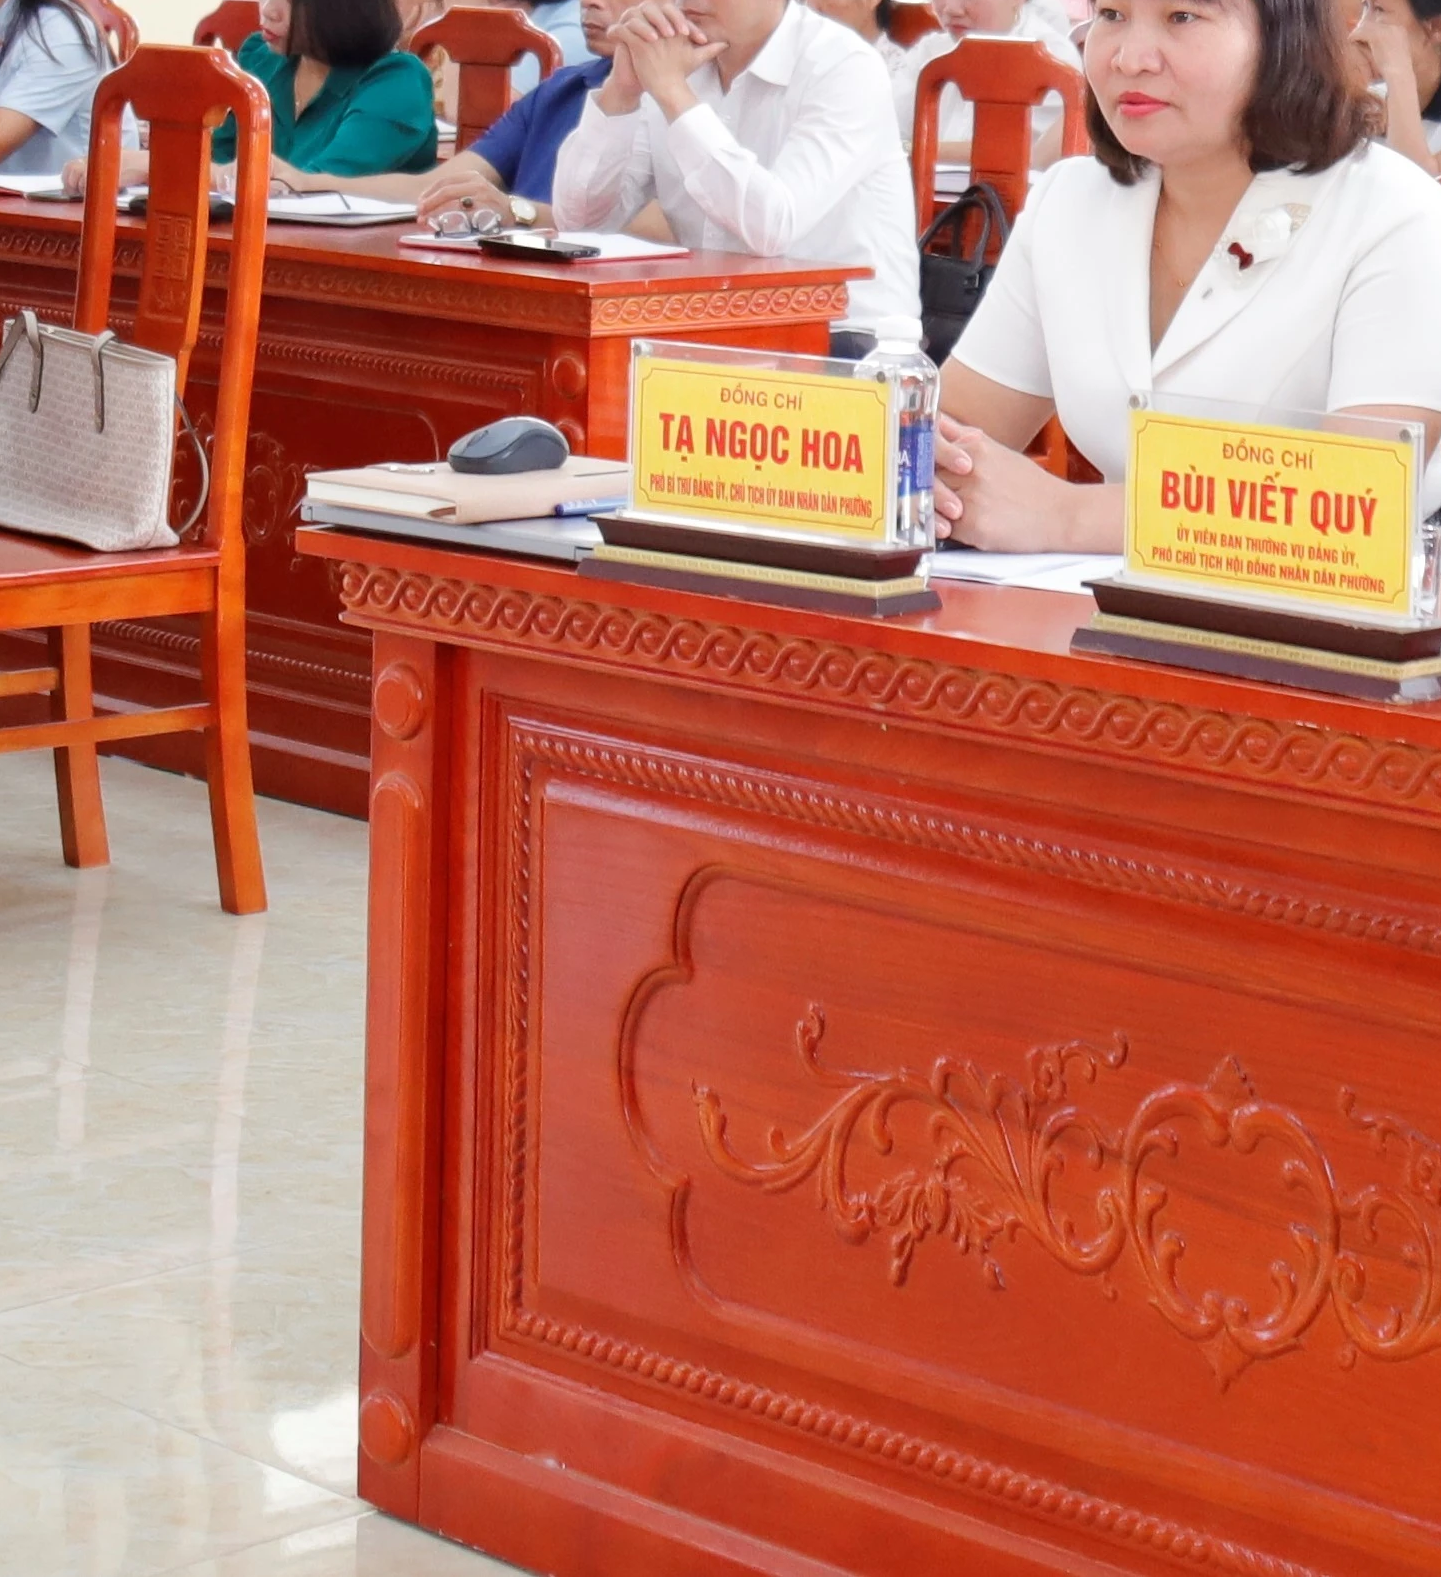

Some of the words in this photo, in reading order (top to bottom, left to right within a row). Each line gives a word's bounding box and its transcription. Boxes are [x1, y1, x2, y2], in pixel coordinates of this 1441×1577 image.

[721, 383, 768, 407] ĐỒNG
[774, 391, 802, 411] CHÍ
[659, 413, 694, 462] TẠ
[706, 418, 789, 471] NGỌC
[802, 429, 864, 474] HOA
[1223, 438, 1274, 464] ĐỒNG
[1282, 448, 1313, 470] CHÍ
[693, 473, 713, 499] ĐẢNG
[730, 478, 745, 503] CHỦ
[748, 485, 764, 509] TỊCH
[767, 481, 776, 506] ỦY
[779, 489, 794, 508] BAN
[797, 488, 818, 511] NHÂN
[821, 491, 837, 514] DÂN
[840, 494, 872, 518] PHƯỜNG
[1161, 465, 1215, 514] BÙI
[1227, 472, 1298, 526] VIẾT
[1310, 488, 1377, 536] QUÝ
[1152, 545, 1172, 562] PHÓ
[1176, 547, 1196, 566] CHỦ
[1199, 553, 1222, 571] TỊCH
[1226, 555, 1243, 576] HỘI
[1246, 556, 1276, 578] ĐỒNG
[1280, 564, 1310, 583] NHÂN
[1314, 568, 1335, 587] DÂN
[1339, 573, 1385, 593] PHƯỜNG
[1177, 522, 1189, 543] ỦY
[1193, 527, 1217, 546] VIÊN
[1221, 533, 1242, 550] BAN
[1245, 536, 1288, 556] THƯỜNG
[1291, 543, 1304, 562] VỤ
[1308, 541, 1338, 564] ĐẢNG
[1342, 545, 1359, 569] ỦY,
